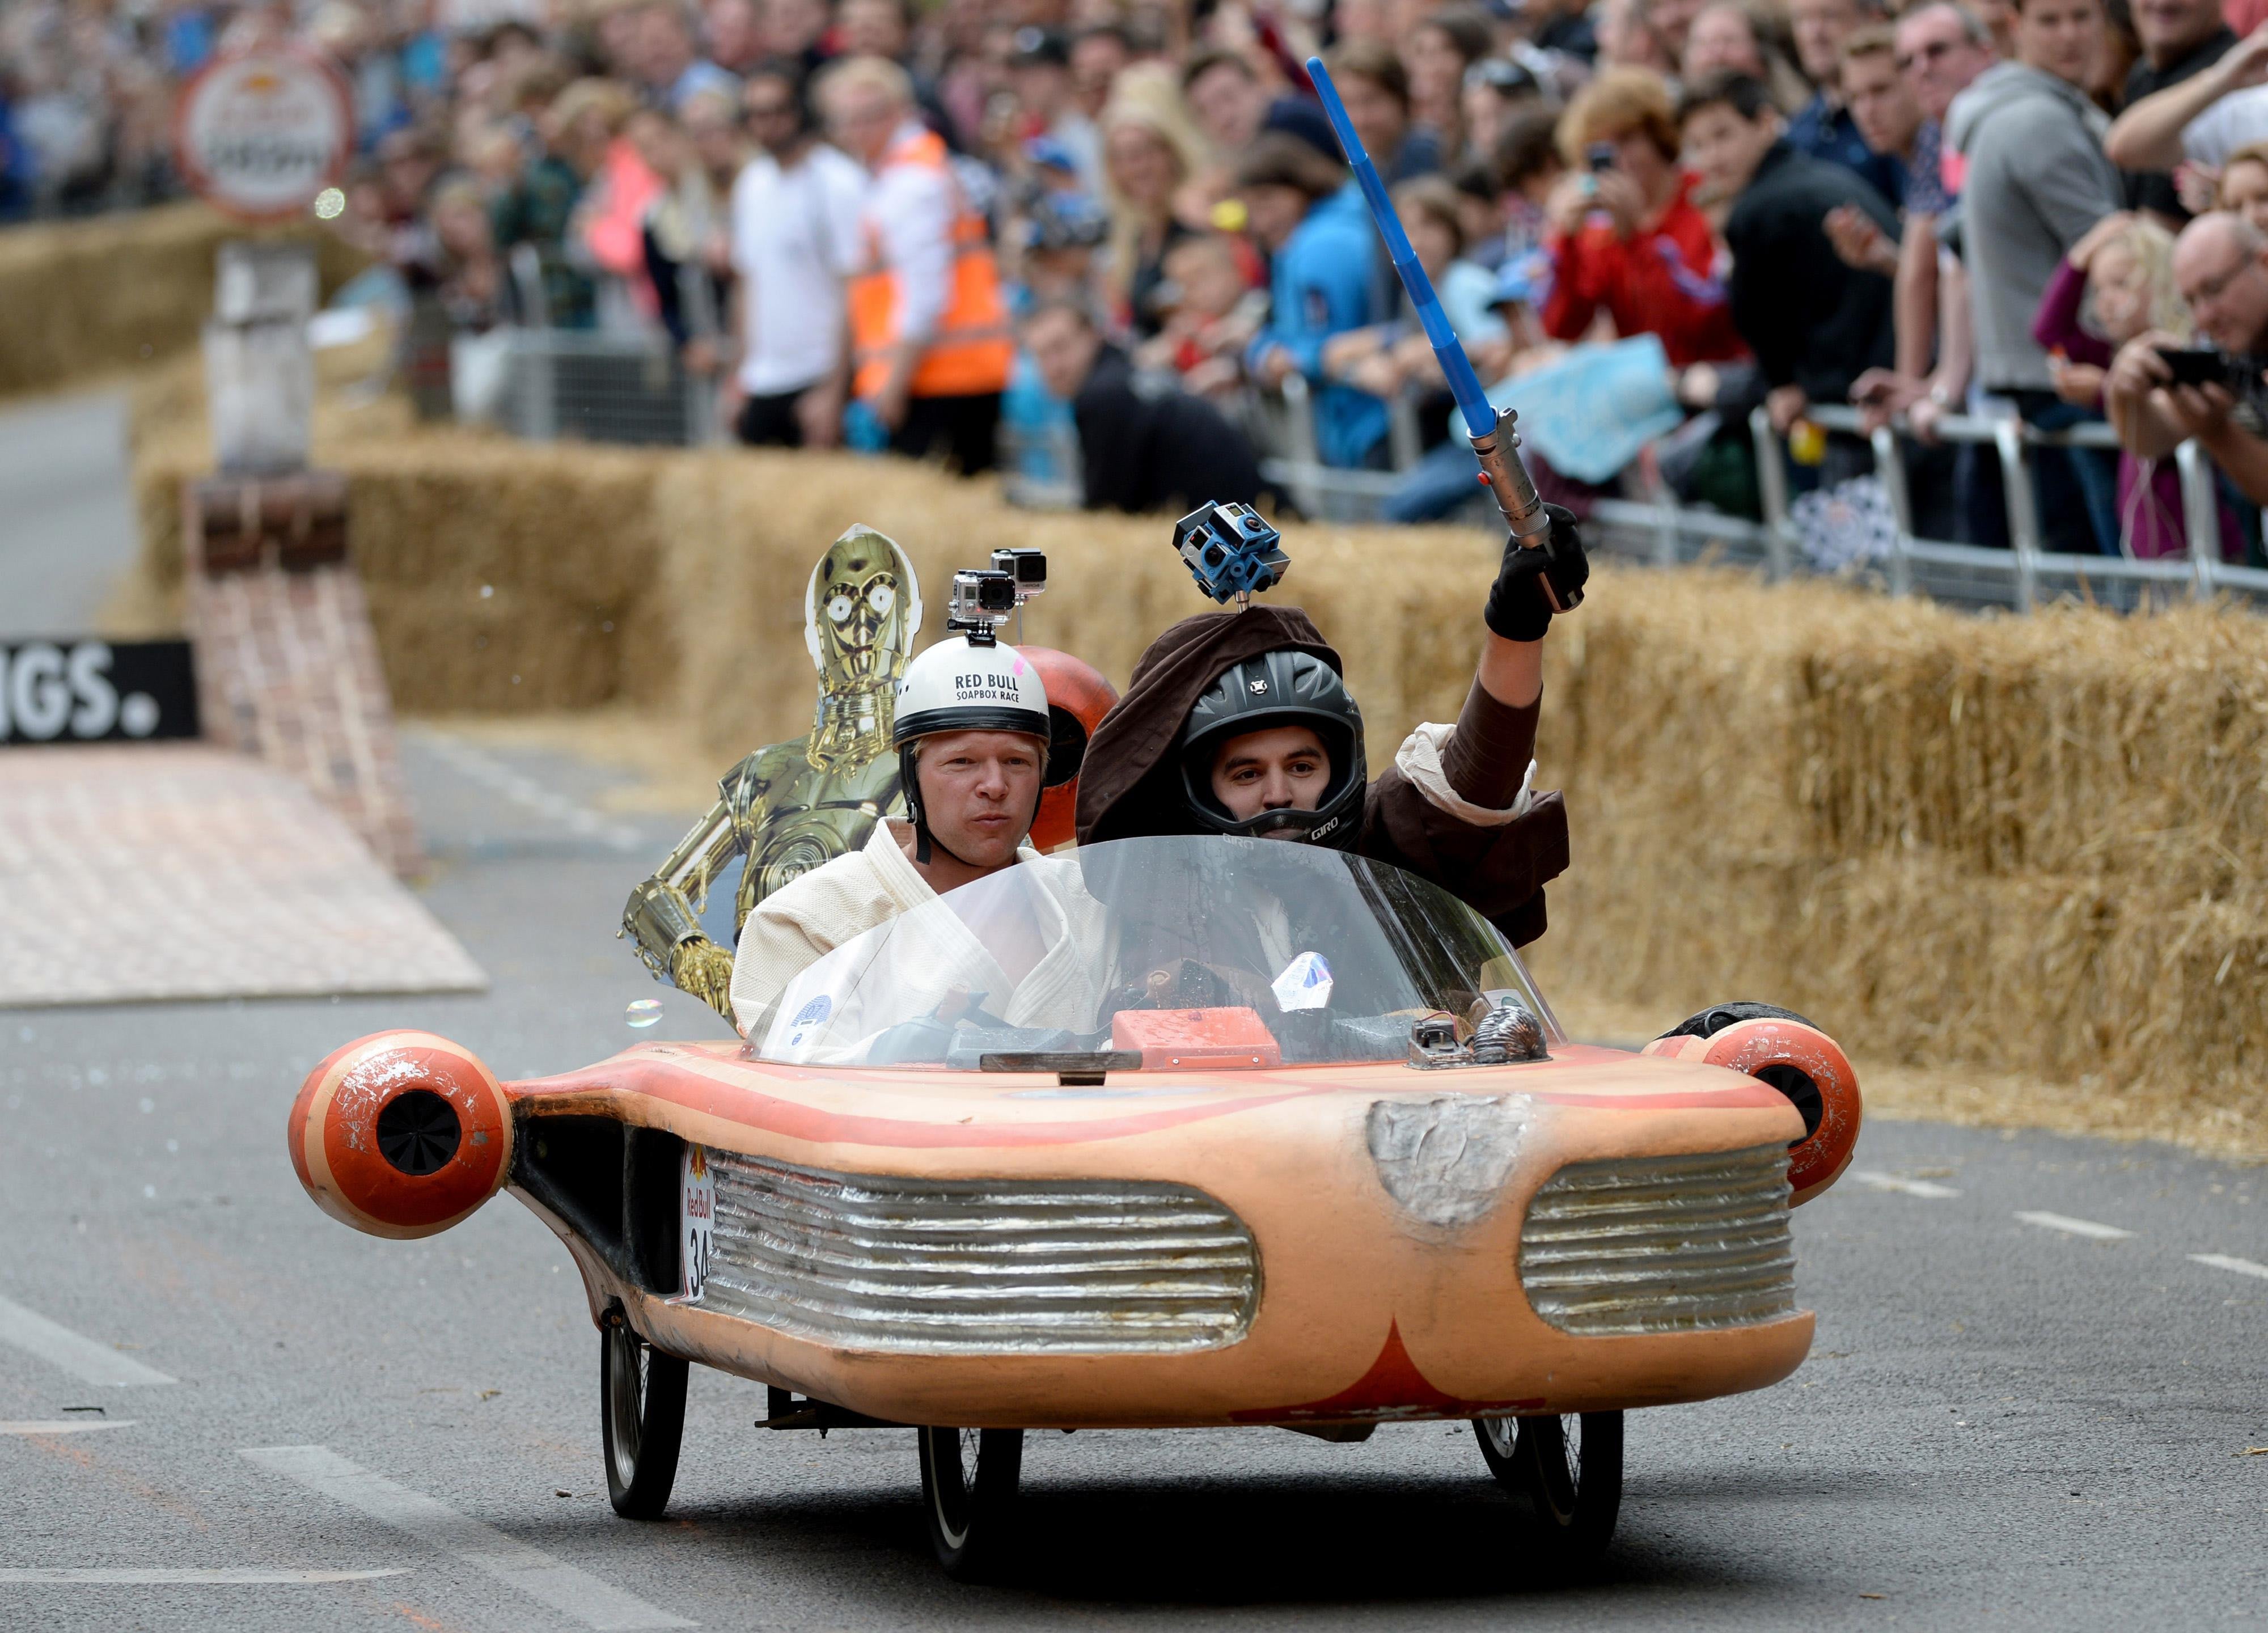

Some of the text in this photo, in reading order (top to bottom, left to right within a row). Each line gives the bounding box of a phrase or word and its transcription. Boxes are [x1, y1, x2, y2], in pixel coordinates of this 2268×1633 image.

[0, 642, 160, 739] GS.
[955, 674, 1018, 691] RED BULL
[957, 690, 1019, 703] SOAPBOX RACE
[1311, 816, 1338, 840] GIRO
[1222, 832, 1254, 850] GIRO
[691, 1228, 709, 1297] 34
